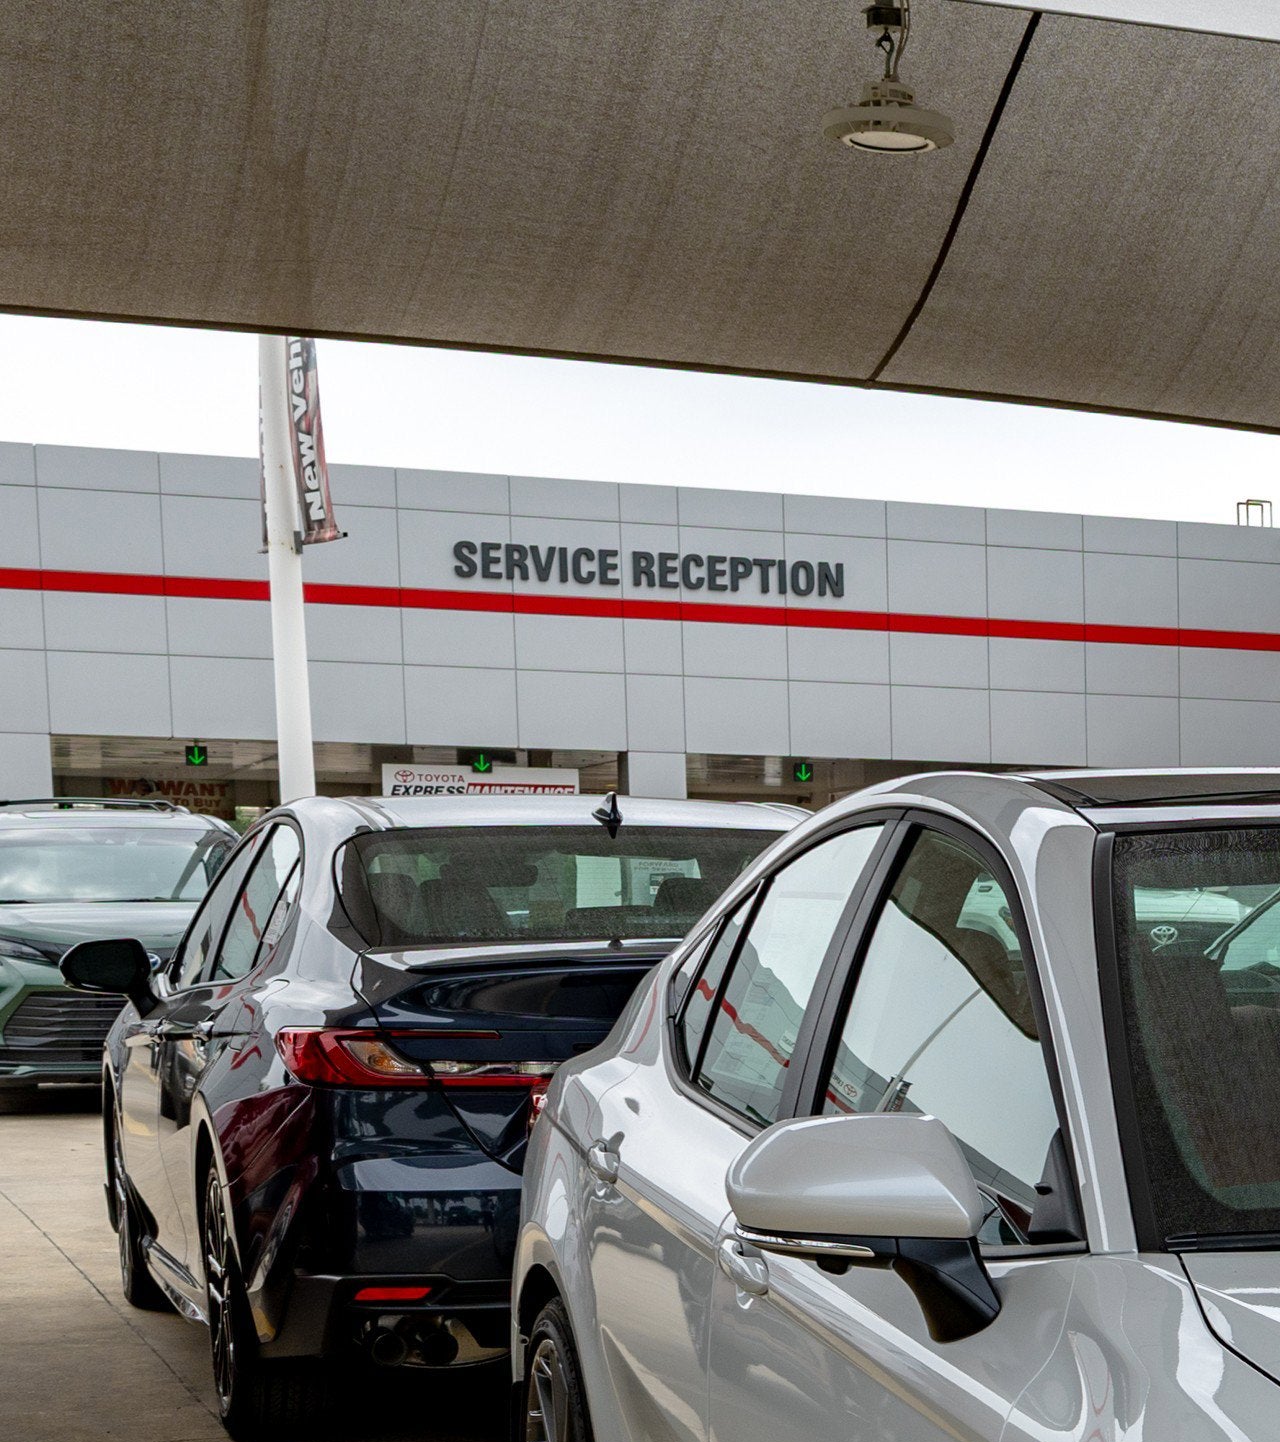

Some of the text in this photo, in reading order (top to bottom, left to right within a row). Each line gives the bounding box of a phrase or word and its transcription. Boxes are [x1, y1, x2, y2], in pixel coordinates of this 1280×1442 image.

[298, 432, 326, 522] New
[453, 540, 846, 598] SERVICE RECEPTION
[419, 773, 465, 783] TOYOTA
[156, 779, 230, 798] WANT
[391, 784, 466, 796] EXPRESS
